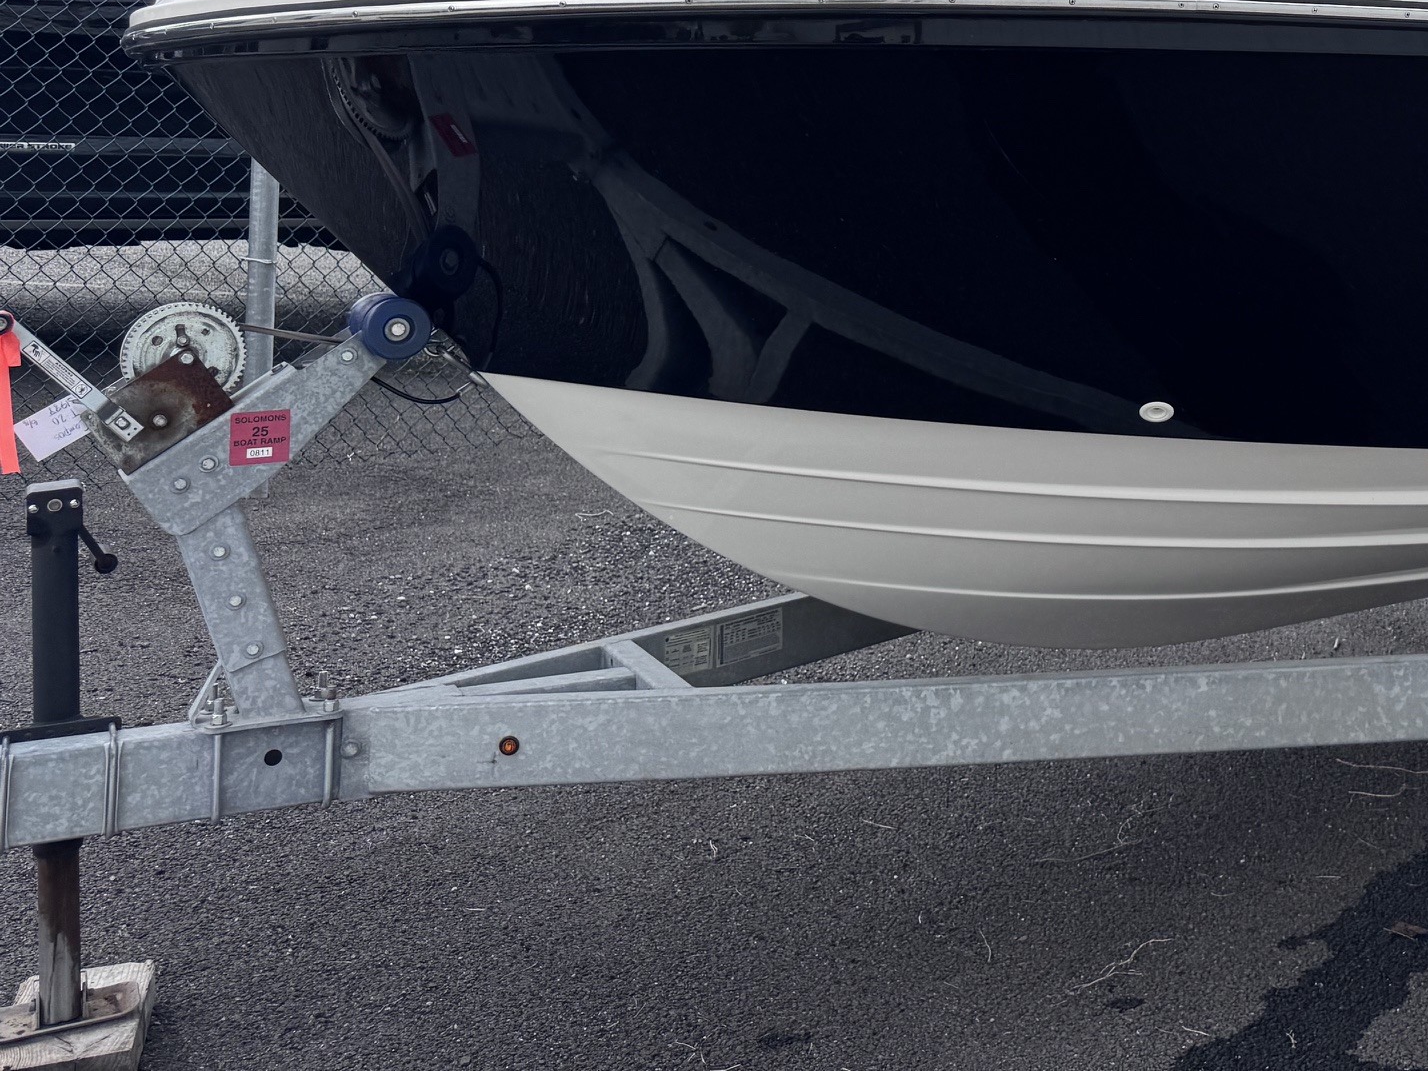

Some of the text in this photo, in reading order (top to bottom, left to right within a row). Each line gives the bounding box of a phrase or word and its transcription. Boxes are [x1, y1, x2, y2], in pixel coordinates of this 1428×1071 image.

[234, 414, 287, 424] SOLOMONS
[252, 426, 269, 437] 25
[233, 436, 287, 447] BOAT RAMP
[249, 449, 270, 457] 0811
